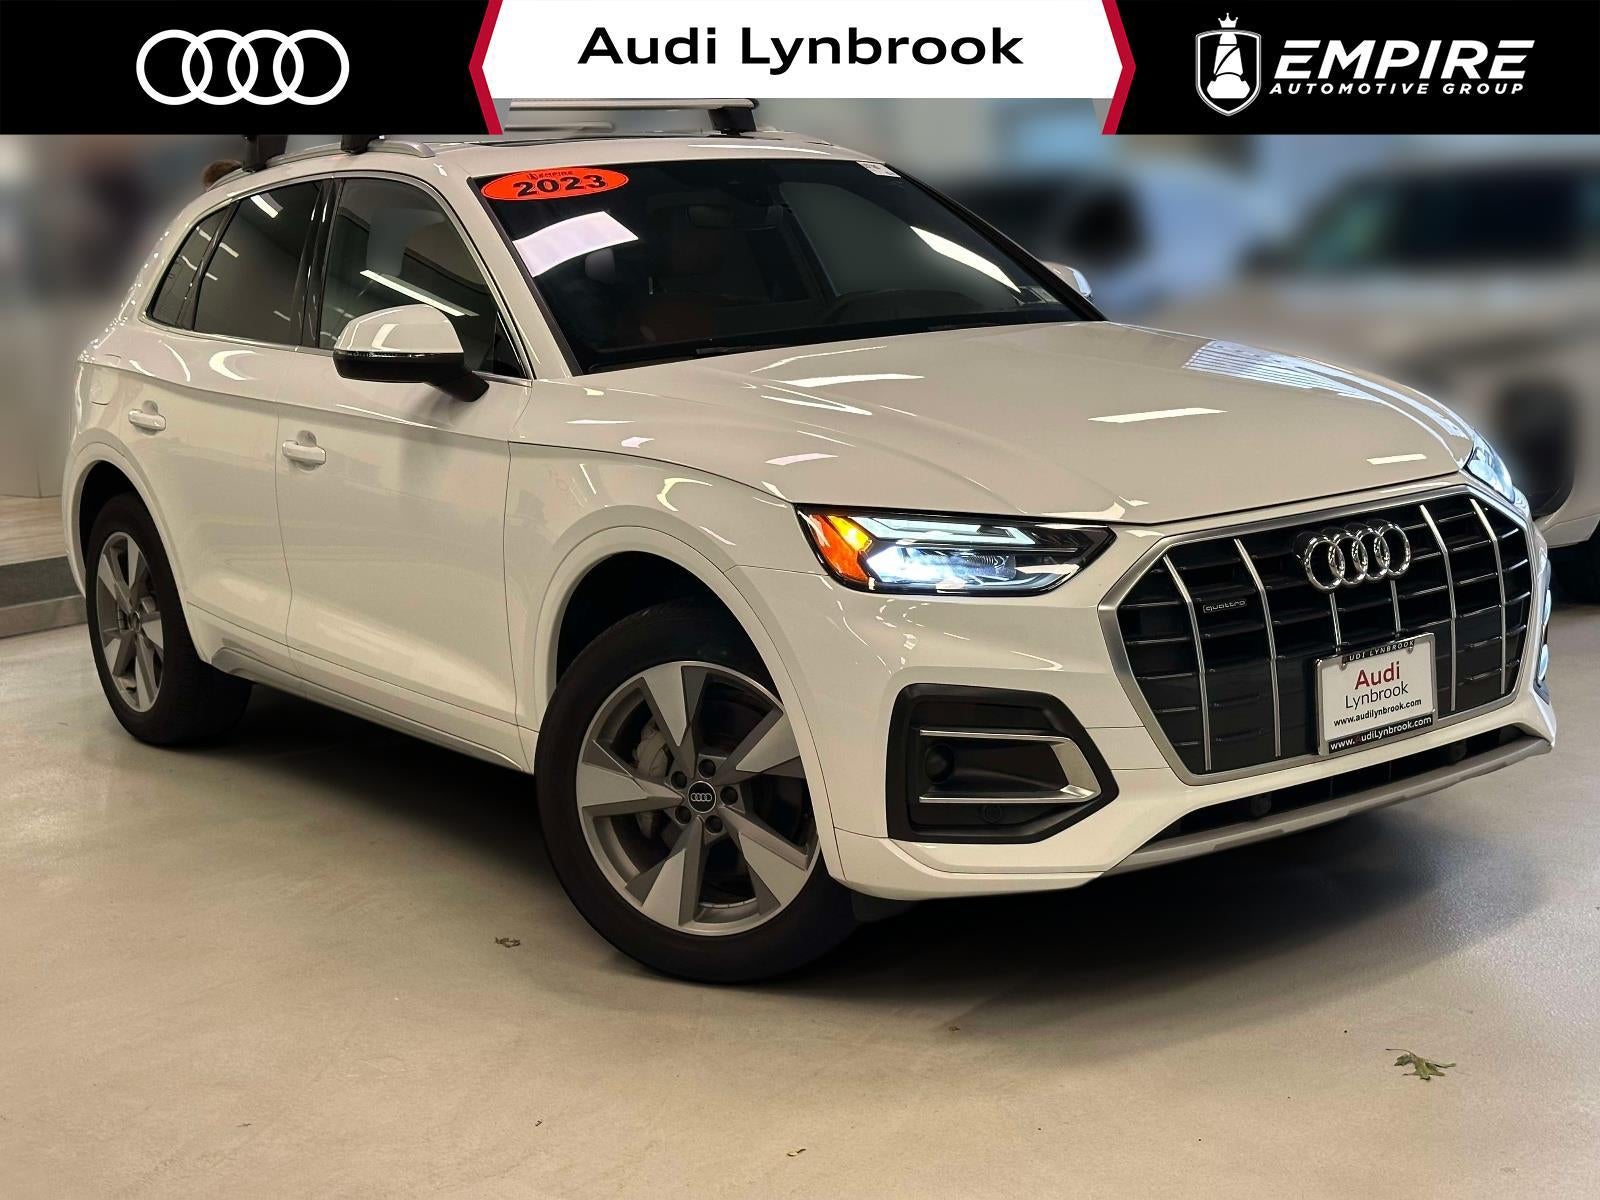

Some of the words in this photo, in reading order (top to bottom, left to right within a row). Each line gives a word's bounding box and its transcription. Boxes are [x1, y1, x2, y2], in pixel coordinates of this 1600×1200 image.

[512, 174, 607, 197] 2023
[1205, 600, 1247, 612] quattro
[1342, 651, 1366, 664] UDI
[1369, 640, 1415, 656] LYNBROOK
[1354, 660, 1401, 690] Audi
[1345, 681, 1409, 710] Lynbrook
[1333, 698, 1422, 727] www.audilynbrook.com
